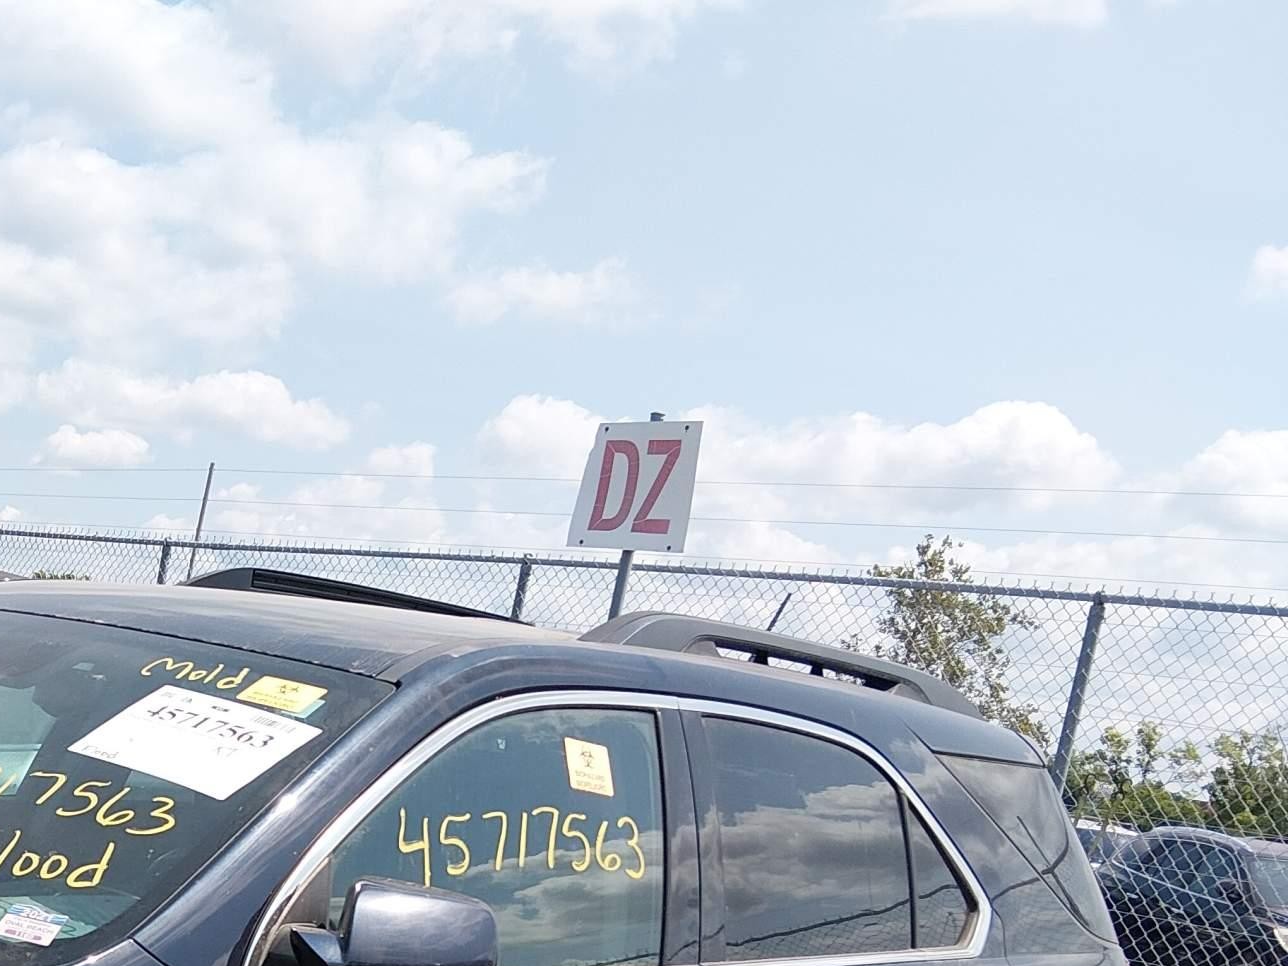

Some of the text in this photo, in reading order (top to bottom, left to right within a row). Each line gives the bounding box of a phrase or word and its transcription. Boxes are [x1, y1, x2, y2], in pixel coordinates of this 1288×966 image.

[587, 439, 682, 535] DZ
[140, 656, 251, 690] Mold
[146, 704, 275, 749] 45717563
[397, 806, 646, 888] 45717563
